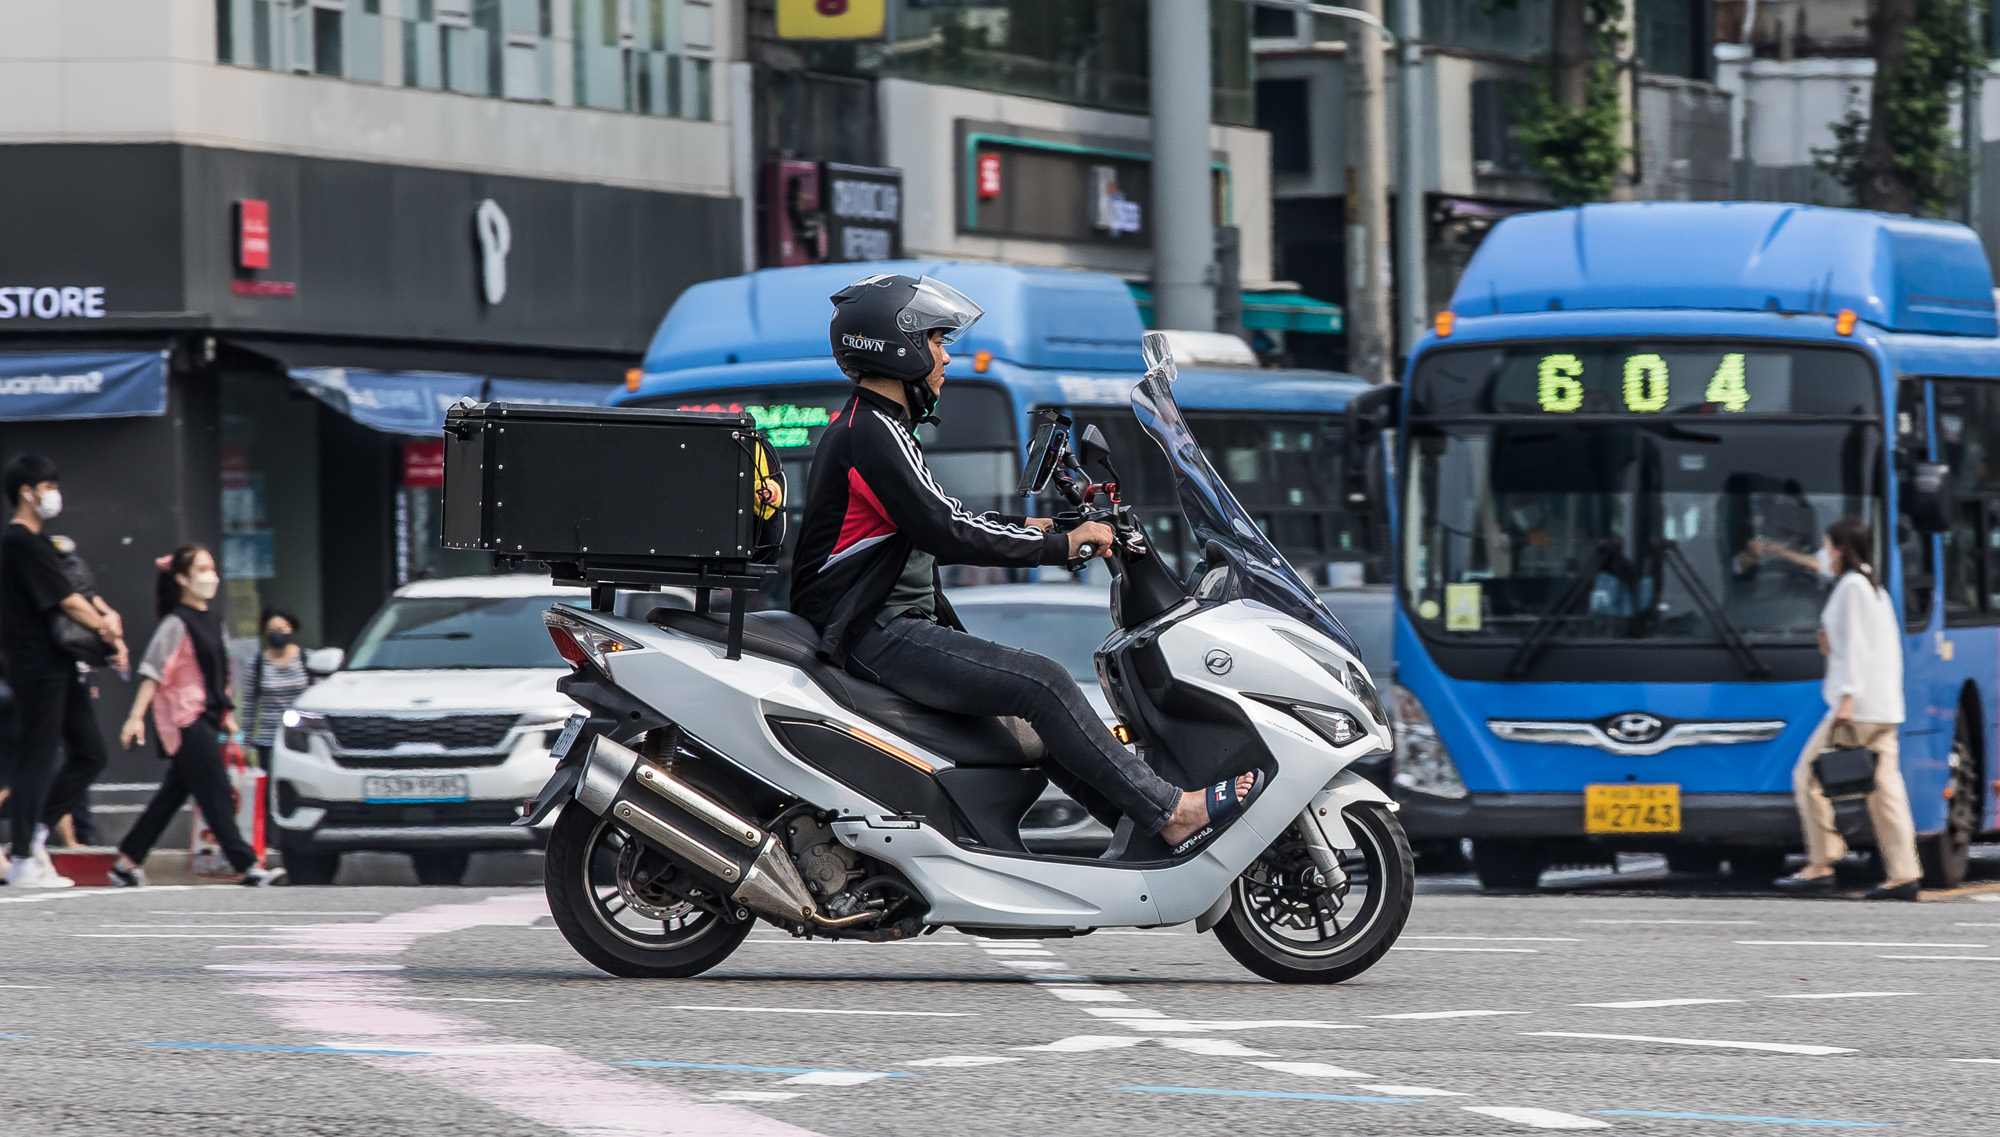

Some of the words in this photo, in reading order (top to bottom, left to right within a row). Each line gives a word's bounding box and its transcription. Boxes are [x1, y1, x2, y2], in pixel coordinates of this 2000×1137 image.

[0, 286, 105, 319] STORE
[842, 335, 885, 352] CROWN
[1537, 353, 1751, 413] 604
[1611, 803, 1675, 828] 2743
